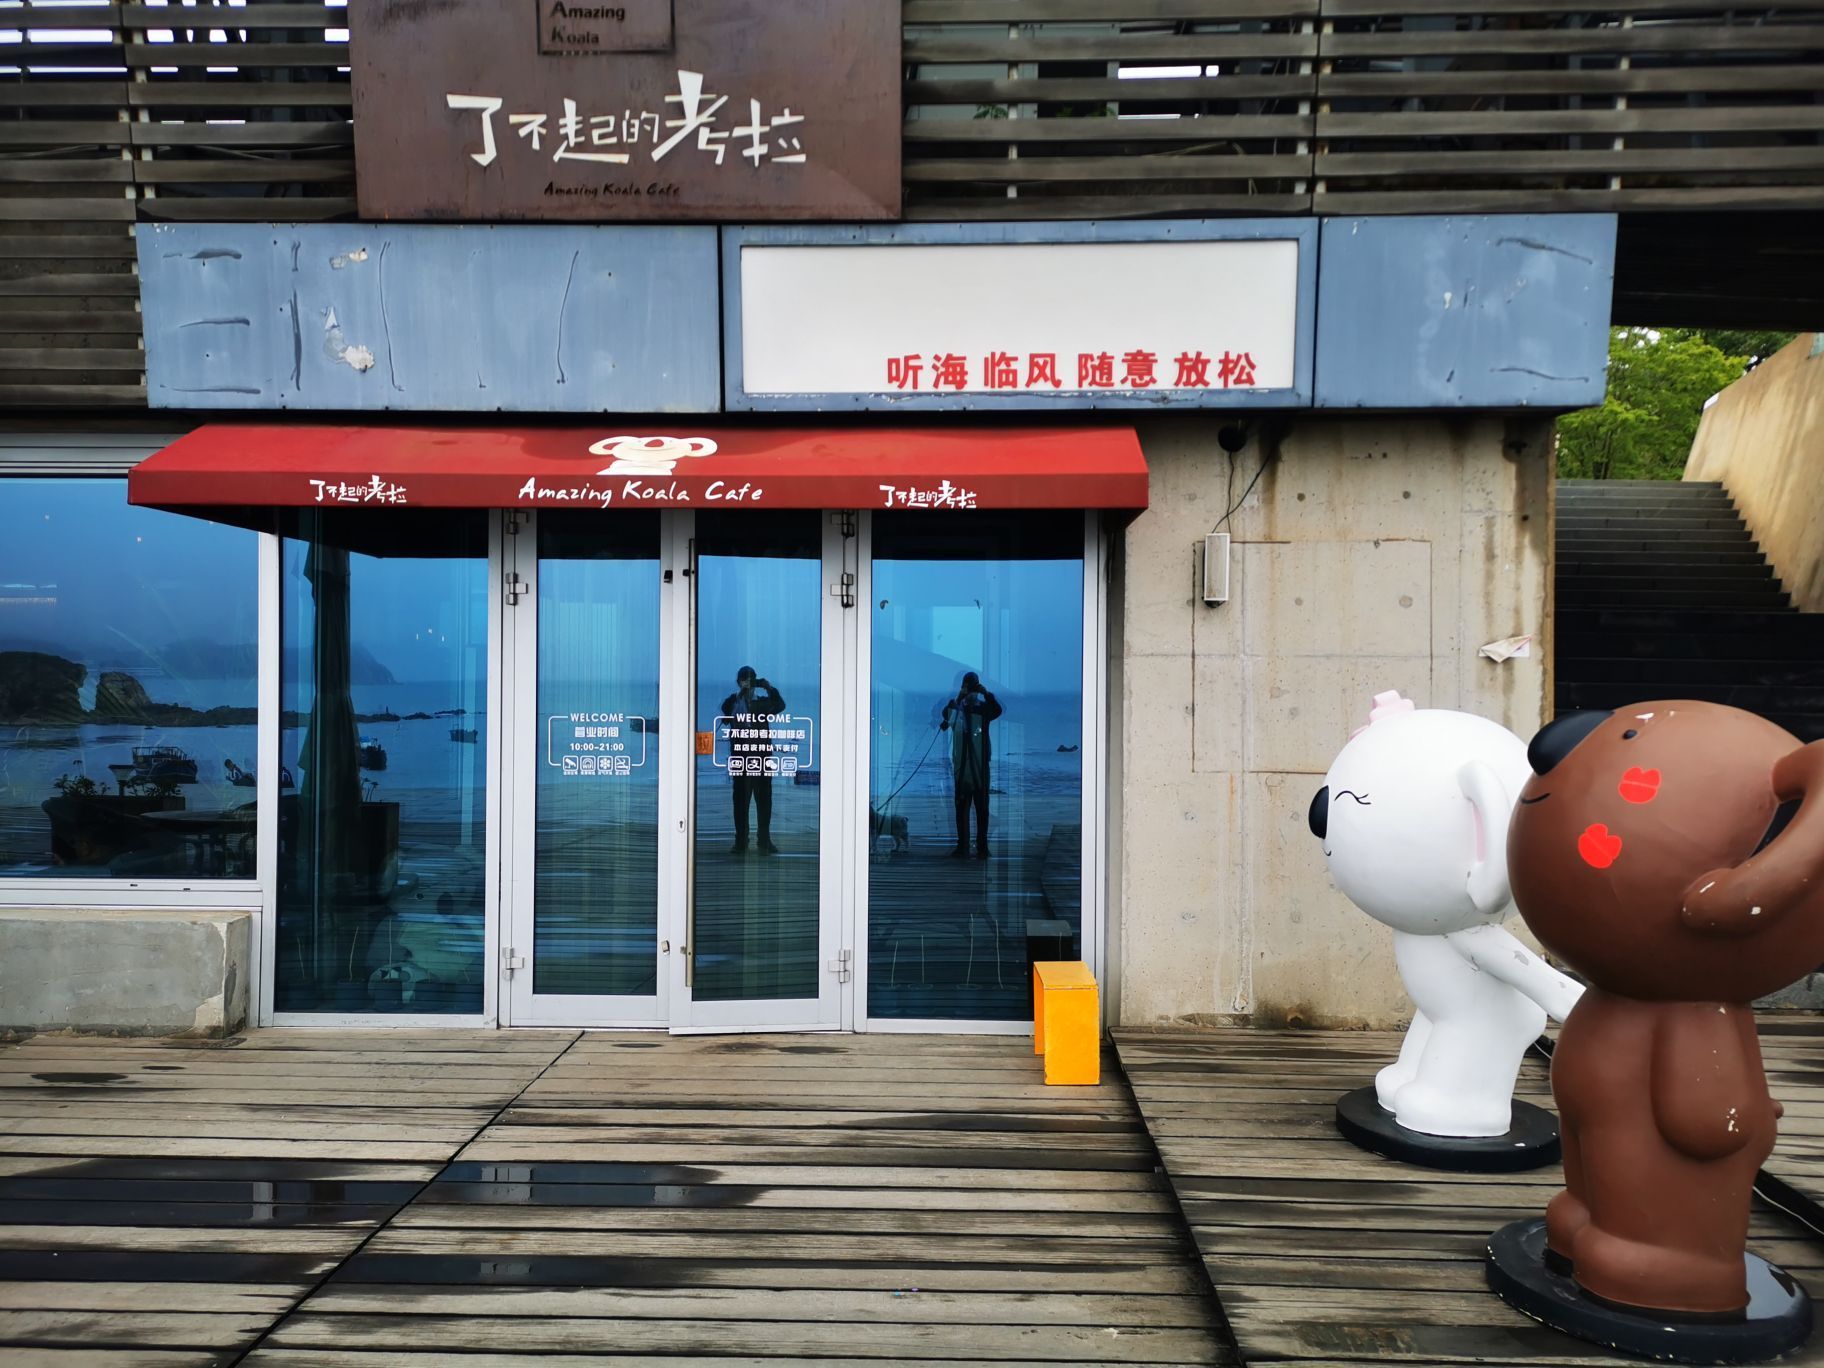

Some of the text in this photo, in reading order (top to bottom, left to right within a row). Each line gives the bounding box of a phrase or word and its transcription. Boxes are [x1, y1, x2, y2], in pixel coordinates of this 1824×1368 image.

[550, 0, 625, 22] Amazing
[551, 25, 600, 44] Koala
[446, 69, 806, 167] 了不起的考拉
[544, 181, 598, 198] Amazing
[603, 182, 641, 196] Koala
[887, 349, 1257, 390] 听海临风随意放松
[309, 474, 407, 504] 了不起的考拉
[518, 477, 763, 508] Amazing Koala Cafe
[879, 480, 977, 509] 了不起的考拉
[570, 713, 624, 722] WELCOME
[736, 713, 791, 723] WELCOME
[569, 742, 624, 751] 10:00-21:00
